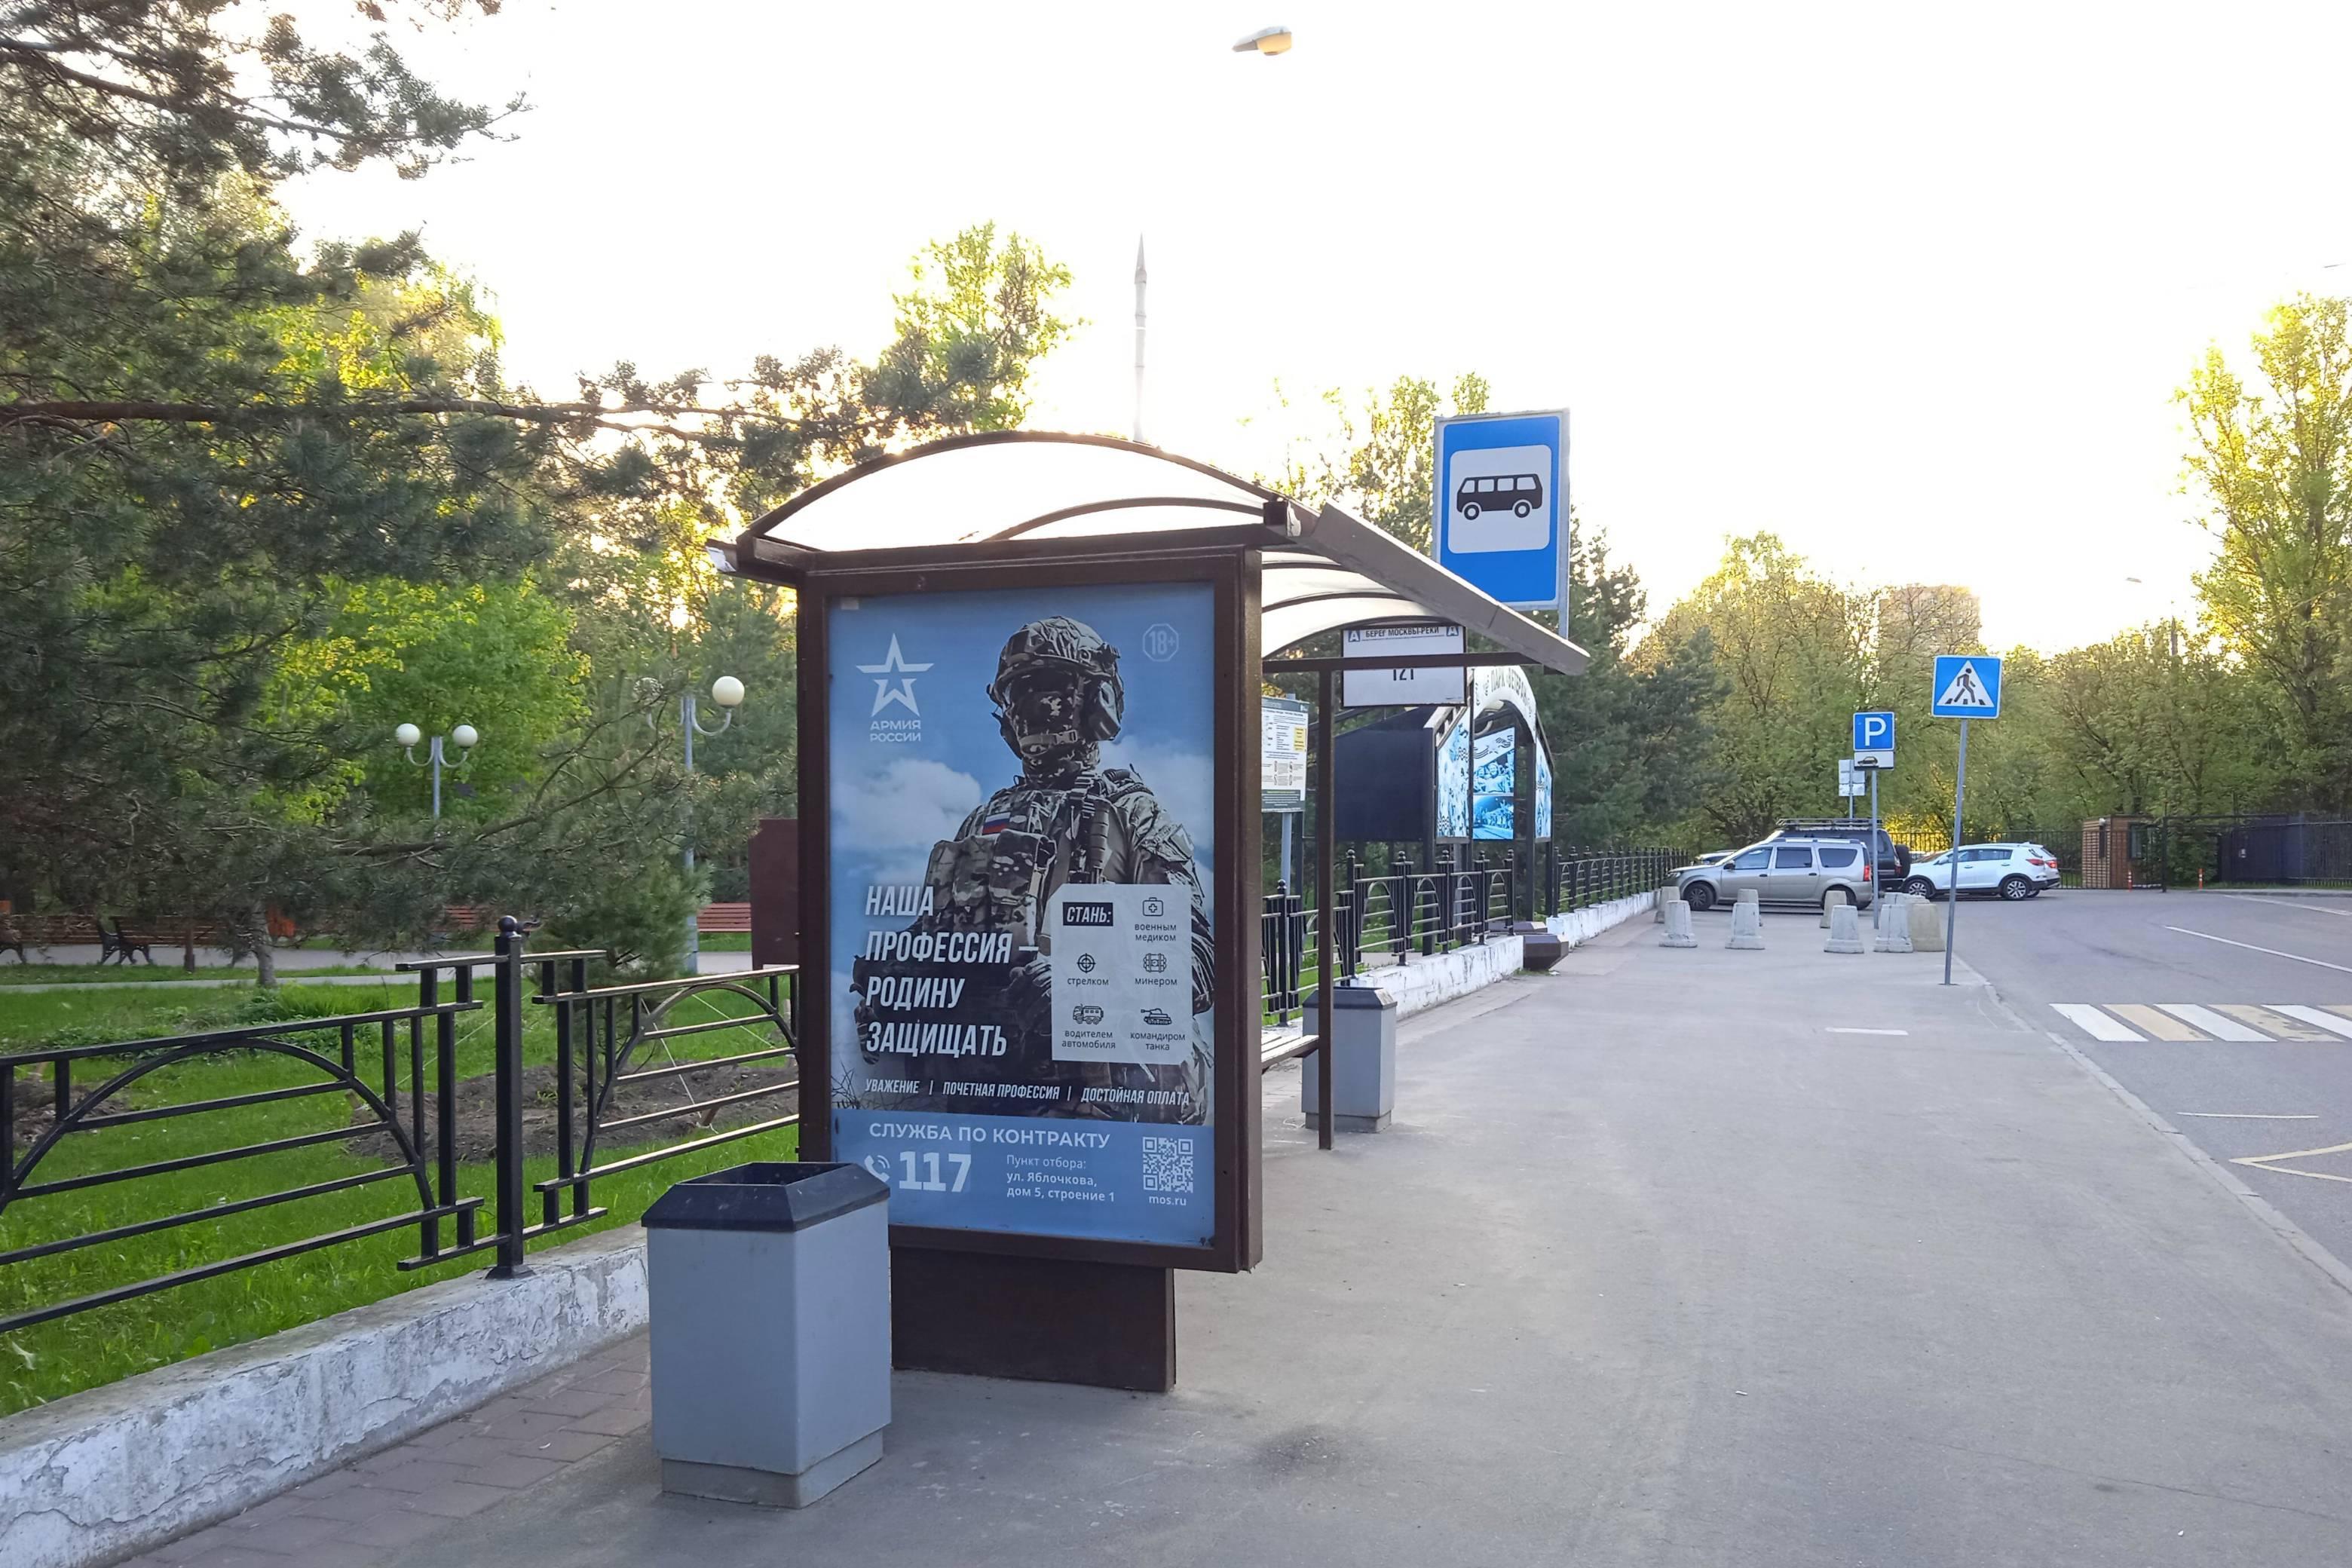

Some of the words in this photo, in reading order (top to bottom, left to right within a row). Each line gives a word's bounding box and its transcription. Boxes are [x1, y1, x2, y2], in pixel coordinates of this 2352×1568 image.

[1365, 629, 1386, 639] БЕРЕГ
[1149, 630, 1176, 655] 18+
[870, 720, 921, 730] АРМИЯ
[1864, 717, 1887, 746] P
[869, 733, 921, 743] РОССИИ
[865, 886, 934, 917] НАША
[1066, 906, 1112, 923] СТАНЬ:
[1135, 923, 1177, 932] военным
[1135, 934, 1177, 942] медиком
[865, 930, 1013, 964] ПРОФЕССИЯ
[1067, 978, 1109, 987] стрелком
[1135, 977, 1178, 988] минером
[865, 976, 966, 1011] РОДИНУ
[865, 1021, 1008, 1058] ЗАЩИЩАТЬ
[1064, 1030, 1113, 1040] водителем
[1130, 1031, 1186, 1042] командиром
[1061, 1040, 1116, 1049] автомобиля
[1146, 1043, 1170, 1051] танка
[865, 1079, 920, 1094] УВАЖЕНИЕ
[942, 1081, 996, 1097] ПОЧЕТНАЯ
[997, 1083, 1060, 1100] ПРОФЕССИЯ
[1080, 1086, 1145, 1104] ДОСТОЙНАЯ
[1147, 1090, 1190, 1106] ОПЛАТА
[869, 1122, 953, 1141] СЛУЖБА
[958, 1126, 987, 1142] ПО
[993, 1128, 1110, 1149] КОНТРАКТУ
[1006, 1154, 1040, 1168] Пункт
[1043, 1157, 1086, 1171] отбора:
[899, 1150, 972, 1193] 117
[1006, 1173, 1024, 1184] ул.
[1027, 1172, 1098, 1187] Яблочкова,
[1006, 1187, 1031, 1199] дом
[1034, 1187, 1045, 1199] 5,
[1048, 1190, 1106, 1202] строение
[1108, 1192, 1115, 1202] 1
[1149, 1196, 1187, 1206] mos.ru
